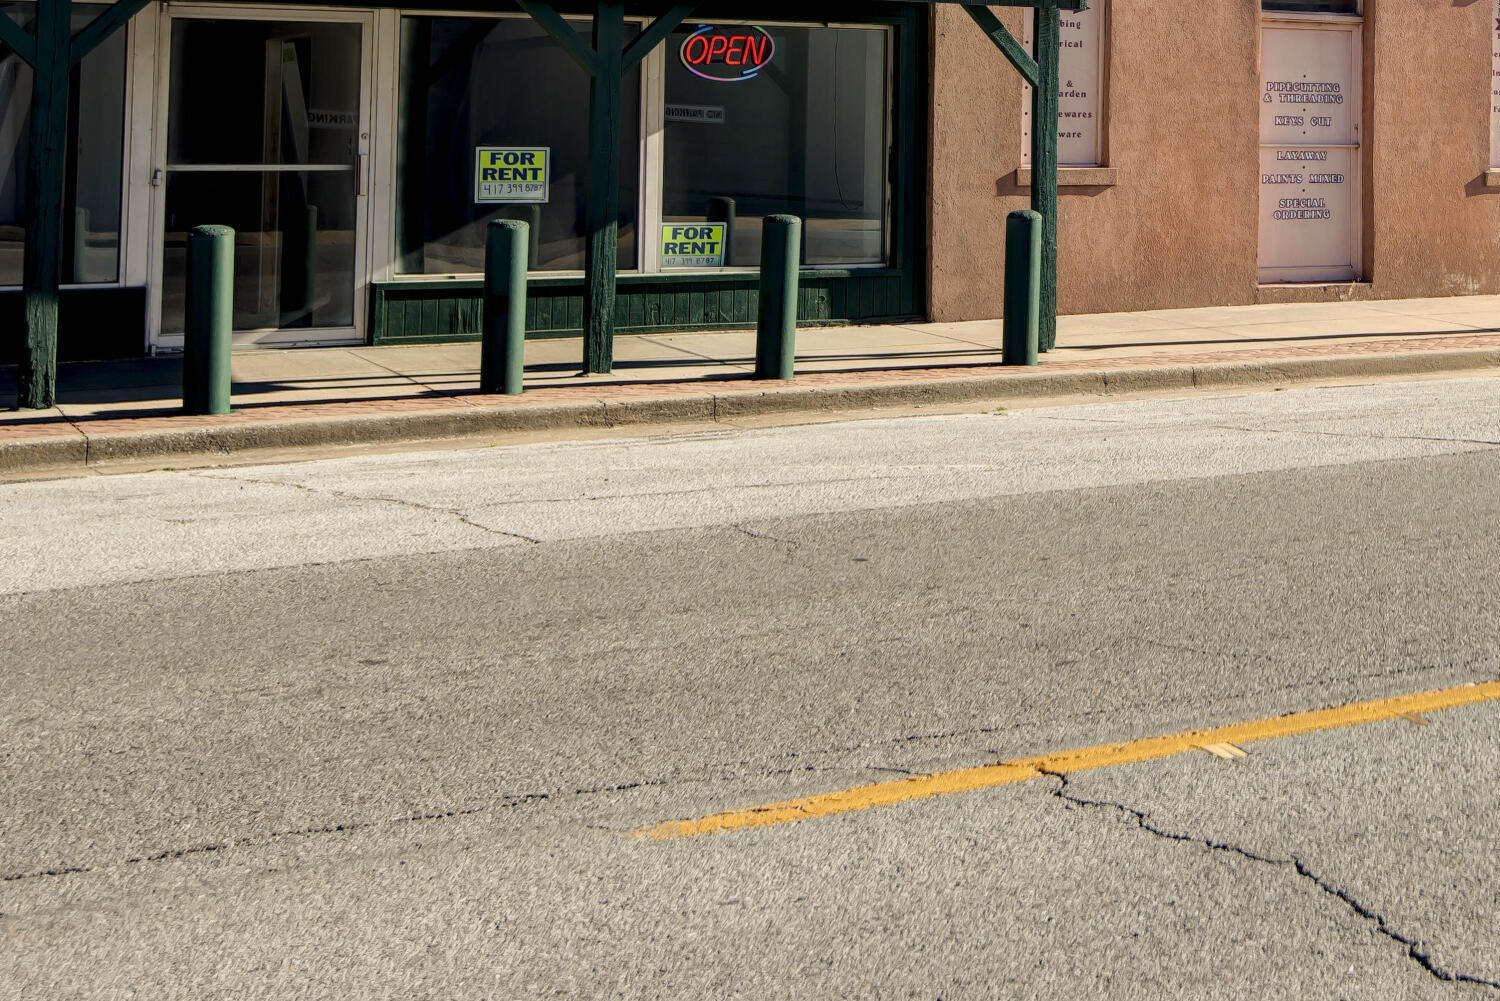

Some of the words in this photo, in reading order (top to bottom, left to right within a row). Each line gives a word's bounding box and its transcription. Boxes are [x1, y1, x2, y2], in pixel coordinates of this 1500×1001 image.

[685, 34, 767, 66] OPEN
[1266, 81, 1340, 93] PIPECUTTING
[1058, 90, 1087, 98] arden
[1263, 93, 1272, 103] &
[1279, 93, 1344, 104] THREADING
[1275, 116, 1304, 126] KEYS
[1310, 116, 1332, 127] CUT
[490, 152, 535, 165] FOR
[1277, 151, 1327, 161] LAYAWAY
[482, 167, 543, 181] RENT
[1262, 174, 1303, 184] PAINTS
[1308, 174, 1344, 184] MIXED
[483, 183, 504, 195] 417
[507, 183, 523, 194] 399
[1279, 198, 1325, 208] SPECIAL
[1273, 209, 1331, 220] ORDERING
[672, 227, 714, 240] FOR
[664, 241, 720, 254] RENT
